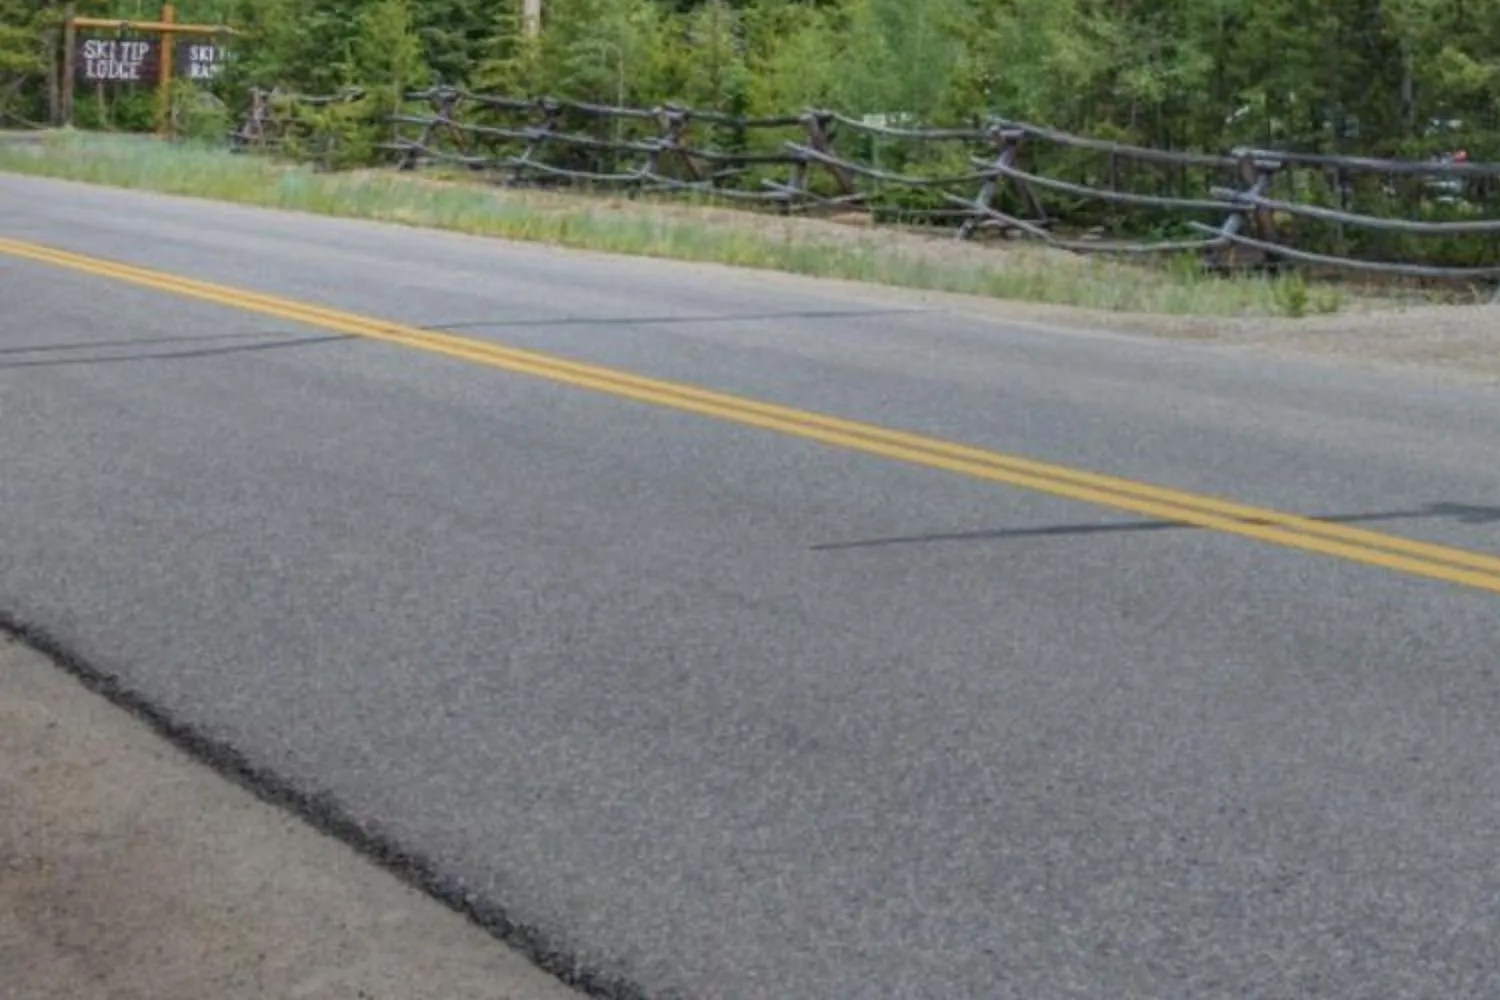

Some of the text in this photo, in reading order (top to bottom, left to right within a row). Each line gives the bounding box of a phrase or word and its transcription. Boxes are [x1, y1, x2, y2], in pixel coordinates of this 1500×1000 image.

[84, 39, 150, 61] SKI TIP
[190, 44, 214, 61] SKI
[86, 59, 142, 79] LODGE
